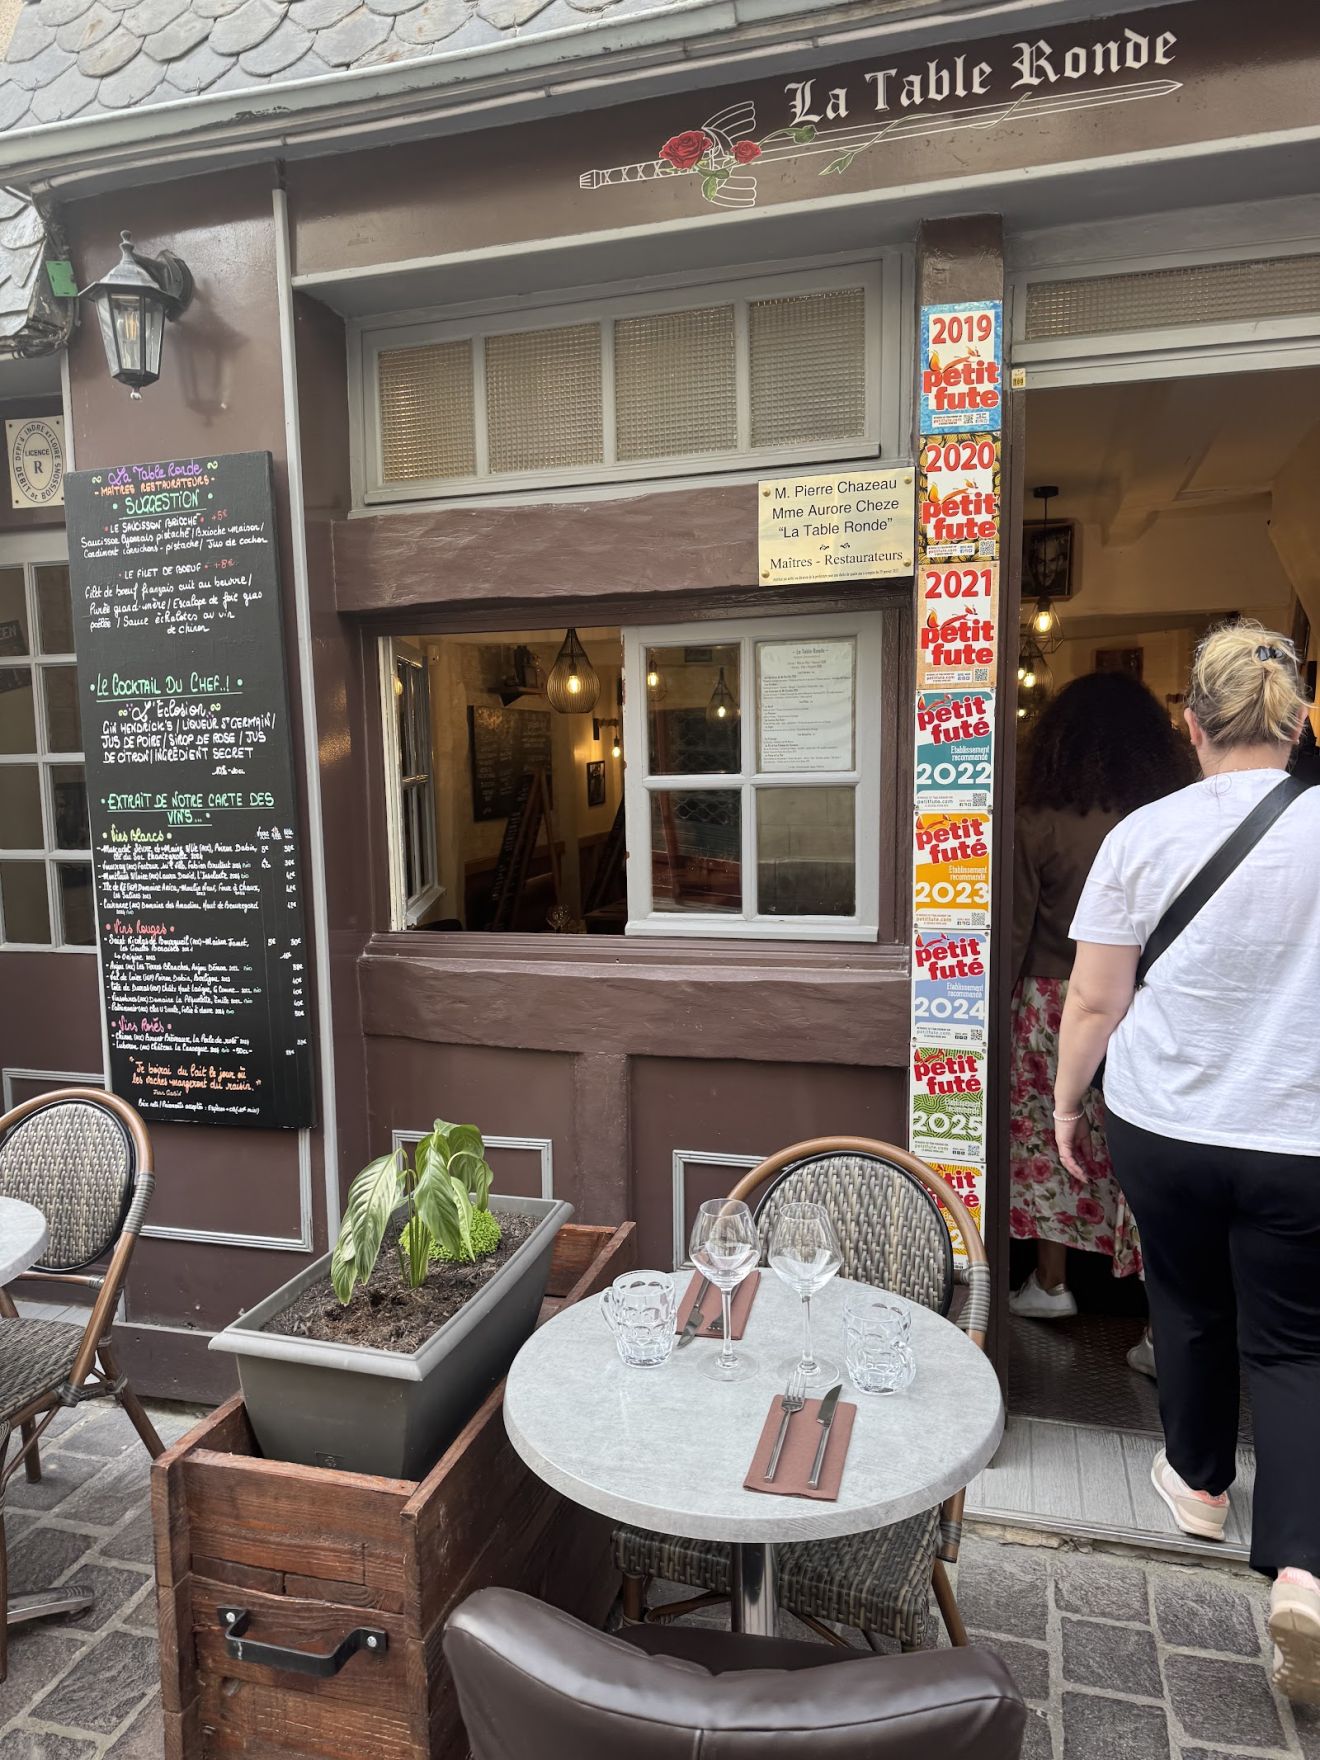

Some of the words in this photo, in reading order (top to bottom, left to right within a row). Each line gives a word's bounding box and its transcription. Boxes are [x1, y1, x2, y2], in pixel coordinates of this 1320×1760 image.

[784, 78, 849, 127] La
[864, 53, 993, 113] Table
[1010, 28, 1177, 90] Ronde
[931, 314, 992, 345] 2019
[923, 360, 1000, 394] petit
[934, 386, 999, 411] fute
[25, 448, 49, 457] LICENCE
[925, 441, 995, 473] 2020
[33, 460, 44, 474] R
[108, 466, 132, 486] La
[132, 464, 166, 480] Table
[168, 460, 203, 477] Ronde
[16, 466, 31, 493] DEBIT
[41, 463, 61, 500] BOISSONS
[140, 474, 210, 493] RESTAURATEURS
[775, 487, 790, 499] M.
[795, 484, 833, 497] Pierre
[837, 479, 897, 494] Chazeau
[772, 507, 804, 520] Mme
[807, 502, 852, 517] Aurore
[856, 499, 900, 513] Cheze
[922, 492, 997, 525] petit
[110, 523, 120, 534] LE
[803, 522, 840, 537] Table
[933, 517, 997, 541] fute
[225, 537, 237, 547] de
[770, 555, 813, 570] Maîtres
[824, 550, 904, 566] Restaurateurs
[124, 570, 134, 580] LE
[162, 566, 174, 576] DE
[924, 568, 993, 599] 2021
[103, 585, 113, 598] de
[198, 580, 212, 589] au
[208, 594, 219, 605] de
[123, 615, 149, 628] Sauce
[203, 611, 215, 620] au
[166, 624, 177, 634] de
[920, 618, 995, 650] petit
[931, 643, 994, 666] fute
[165, 675, 183, 694] DU
[917, 695, 987, 732] petit
[101, 735, 121, 749] JUS
[123, 735, 135, 749] DE
[195, 733, 210, 745] DE
[212, 732, 236, 744] ROSE
[245, 730, 267, 743] JUS
[930, 717, 990, 745] futé
[102, 751, 116, 764] DE
[212, 746, 254, 760] SECRET
[916, 762, 992, 785] 2022
[153, 793, 168, 808] DE
[171, 790, 203, 808] NOTRE
[208, 792, 243, 807] CARTE
[249, 792, 275, 807] DES
[915, 818, 984, 851] petit
[929, 838, 988, 864] futé
[915, 881, 990, 904] 2023
[915, 937, 981, 968] petit
[928, 957, 985, 981] futé
[914, 996, 985, 1020] 2024
[177, 1065, 188, 1076] du
[190, 1063, 207, 1077] lait
[913, 1054, 978, 1082] petit
[209, 1079, 224, 1090] du
[926, 1074, 982, 1095] futé
[912, 1111, 982, 1136] 2025
[943, 1170, 977, 1190] tit
